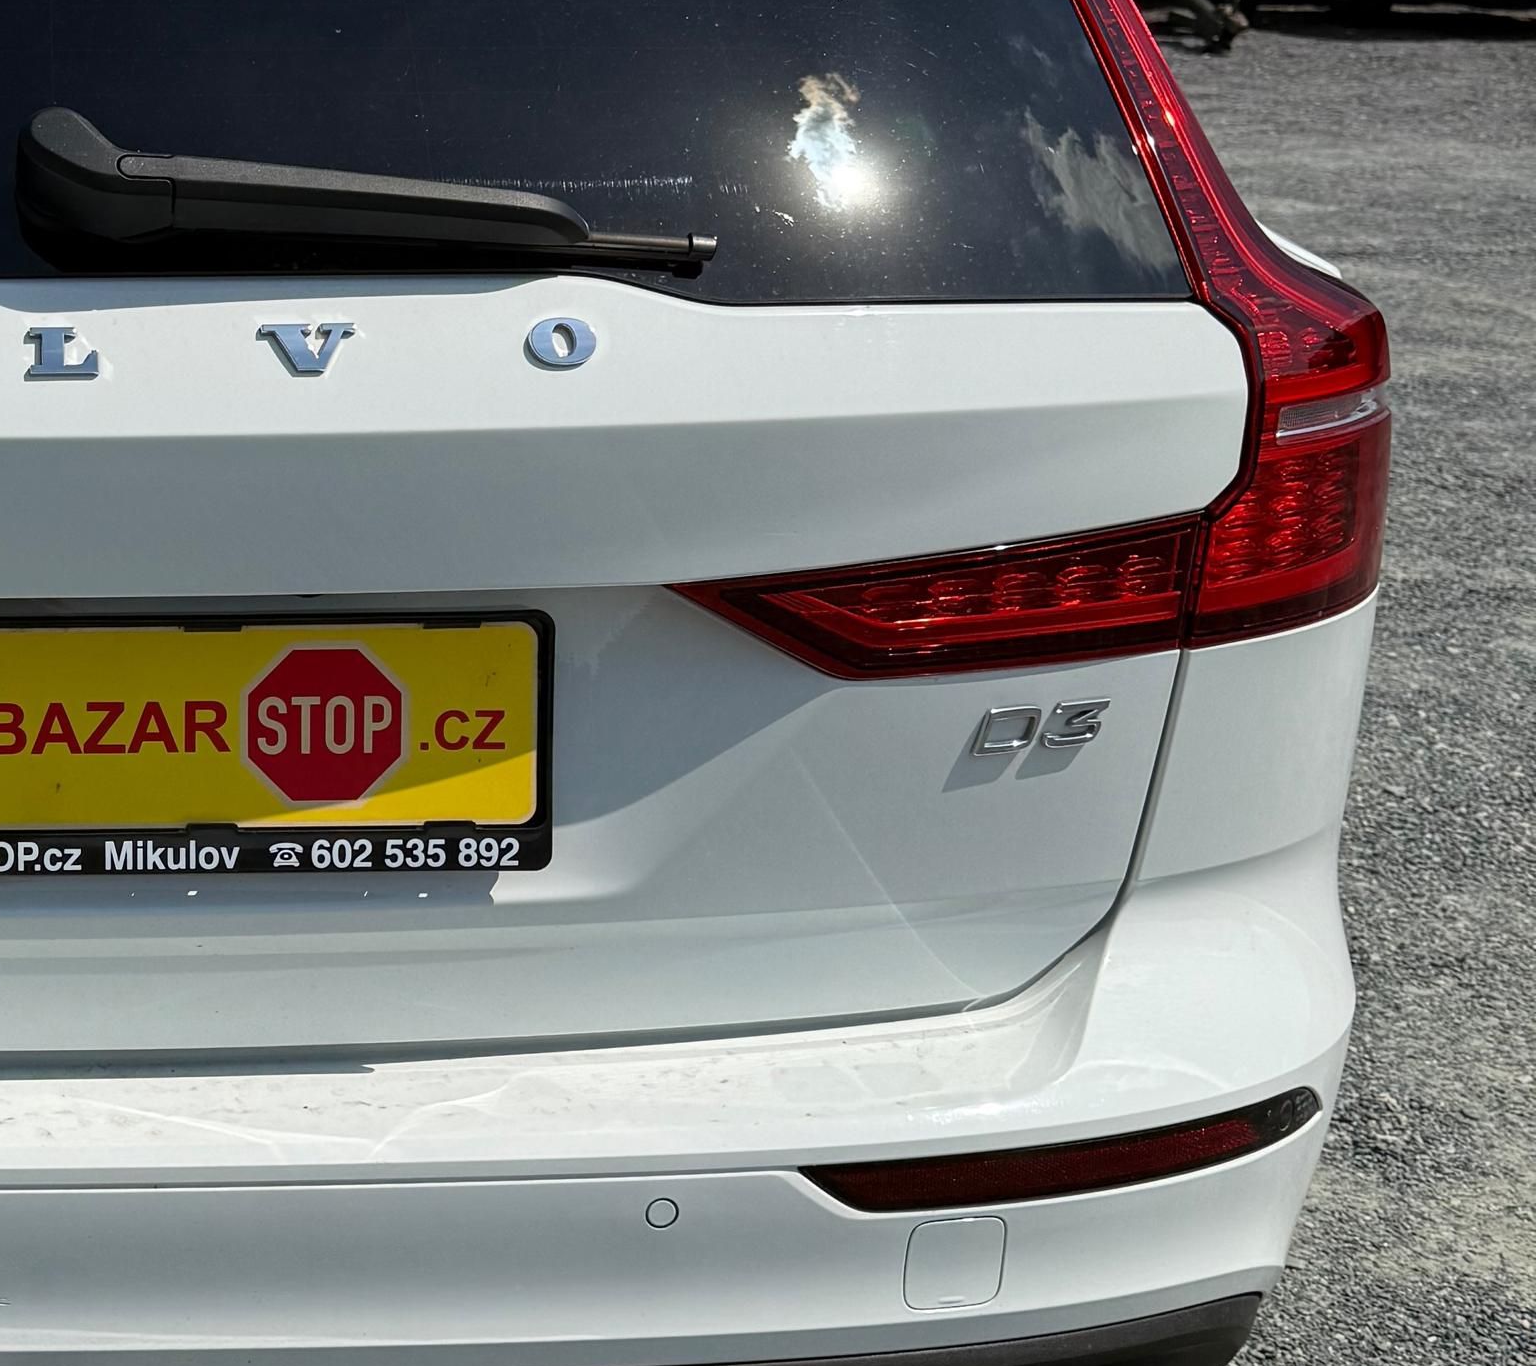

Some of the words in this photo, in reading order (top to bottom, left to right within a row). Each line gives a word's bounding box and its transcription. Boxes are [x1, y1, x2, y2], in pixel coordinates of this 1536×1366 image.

[257, 695, 392, 755] STOP
[971, 698, 1111, 757] D3
[104, 840, 240, 870] Mikulov
[311, 838, 373, 869] 602
[384, 838, 446, 868] 535
[457, 837, 520, 868] 892
